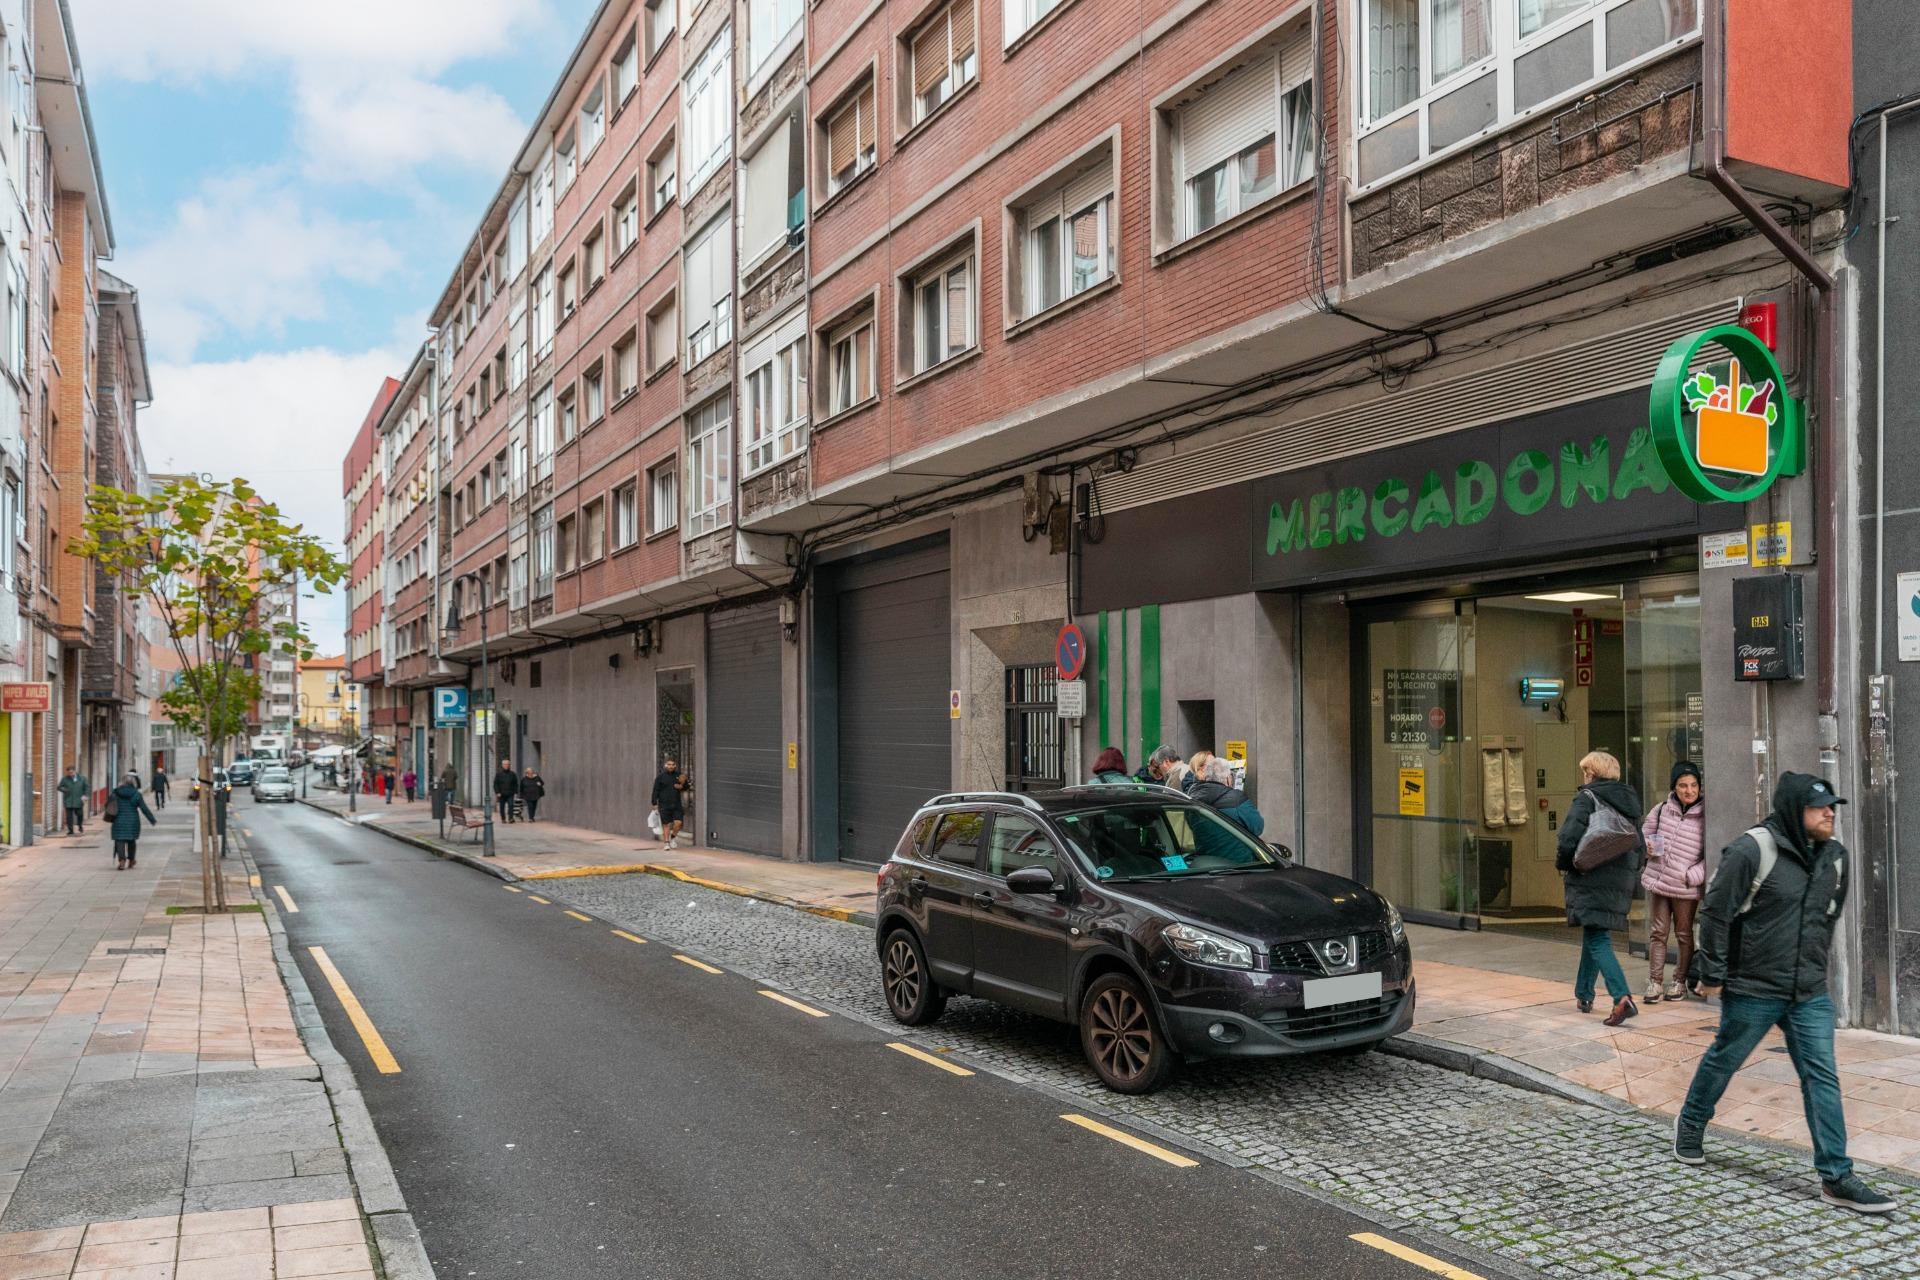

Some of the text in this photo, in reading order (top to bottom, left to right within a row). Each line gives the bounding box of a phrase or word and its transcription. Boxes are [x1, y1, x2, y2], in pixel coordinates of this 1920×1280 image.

[1267, 426, 1671, 556] MERCADONA
[1759, 539, 1784, 548] ALRMA
[1753, 615, 1767, 627] GAS
[1427, 672, 1457, 681] CARROS
[1403, 681, 1436, 690] RECINTO
[437, 690, 459, 718] P
[1390, 713, 1423, 722] HORARIO
[1390, 731, 1427, 742] 9 21:30
